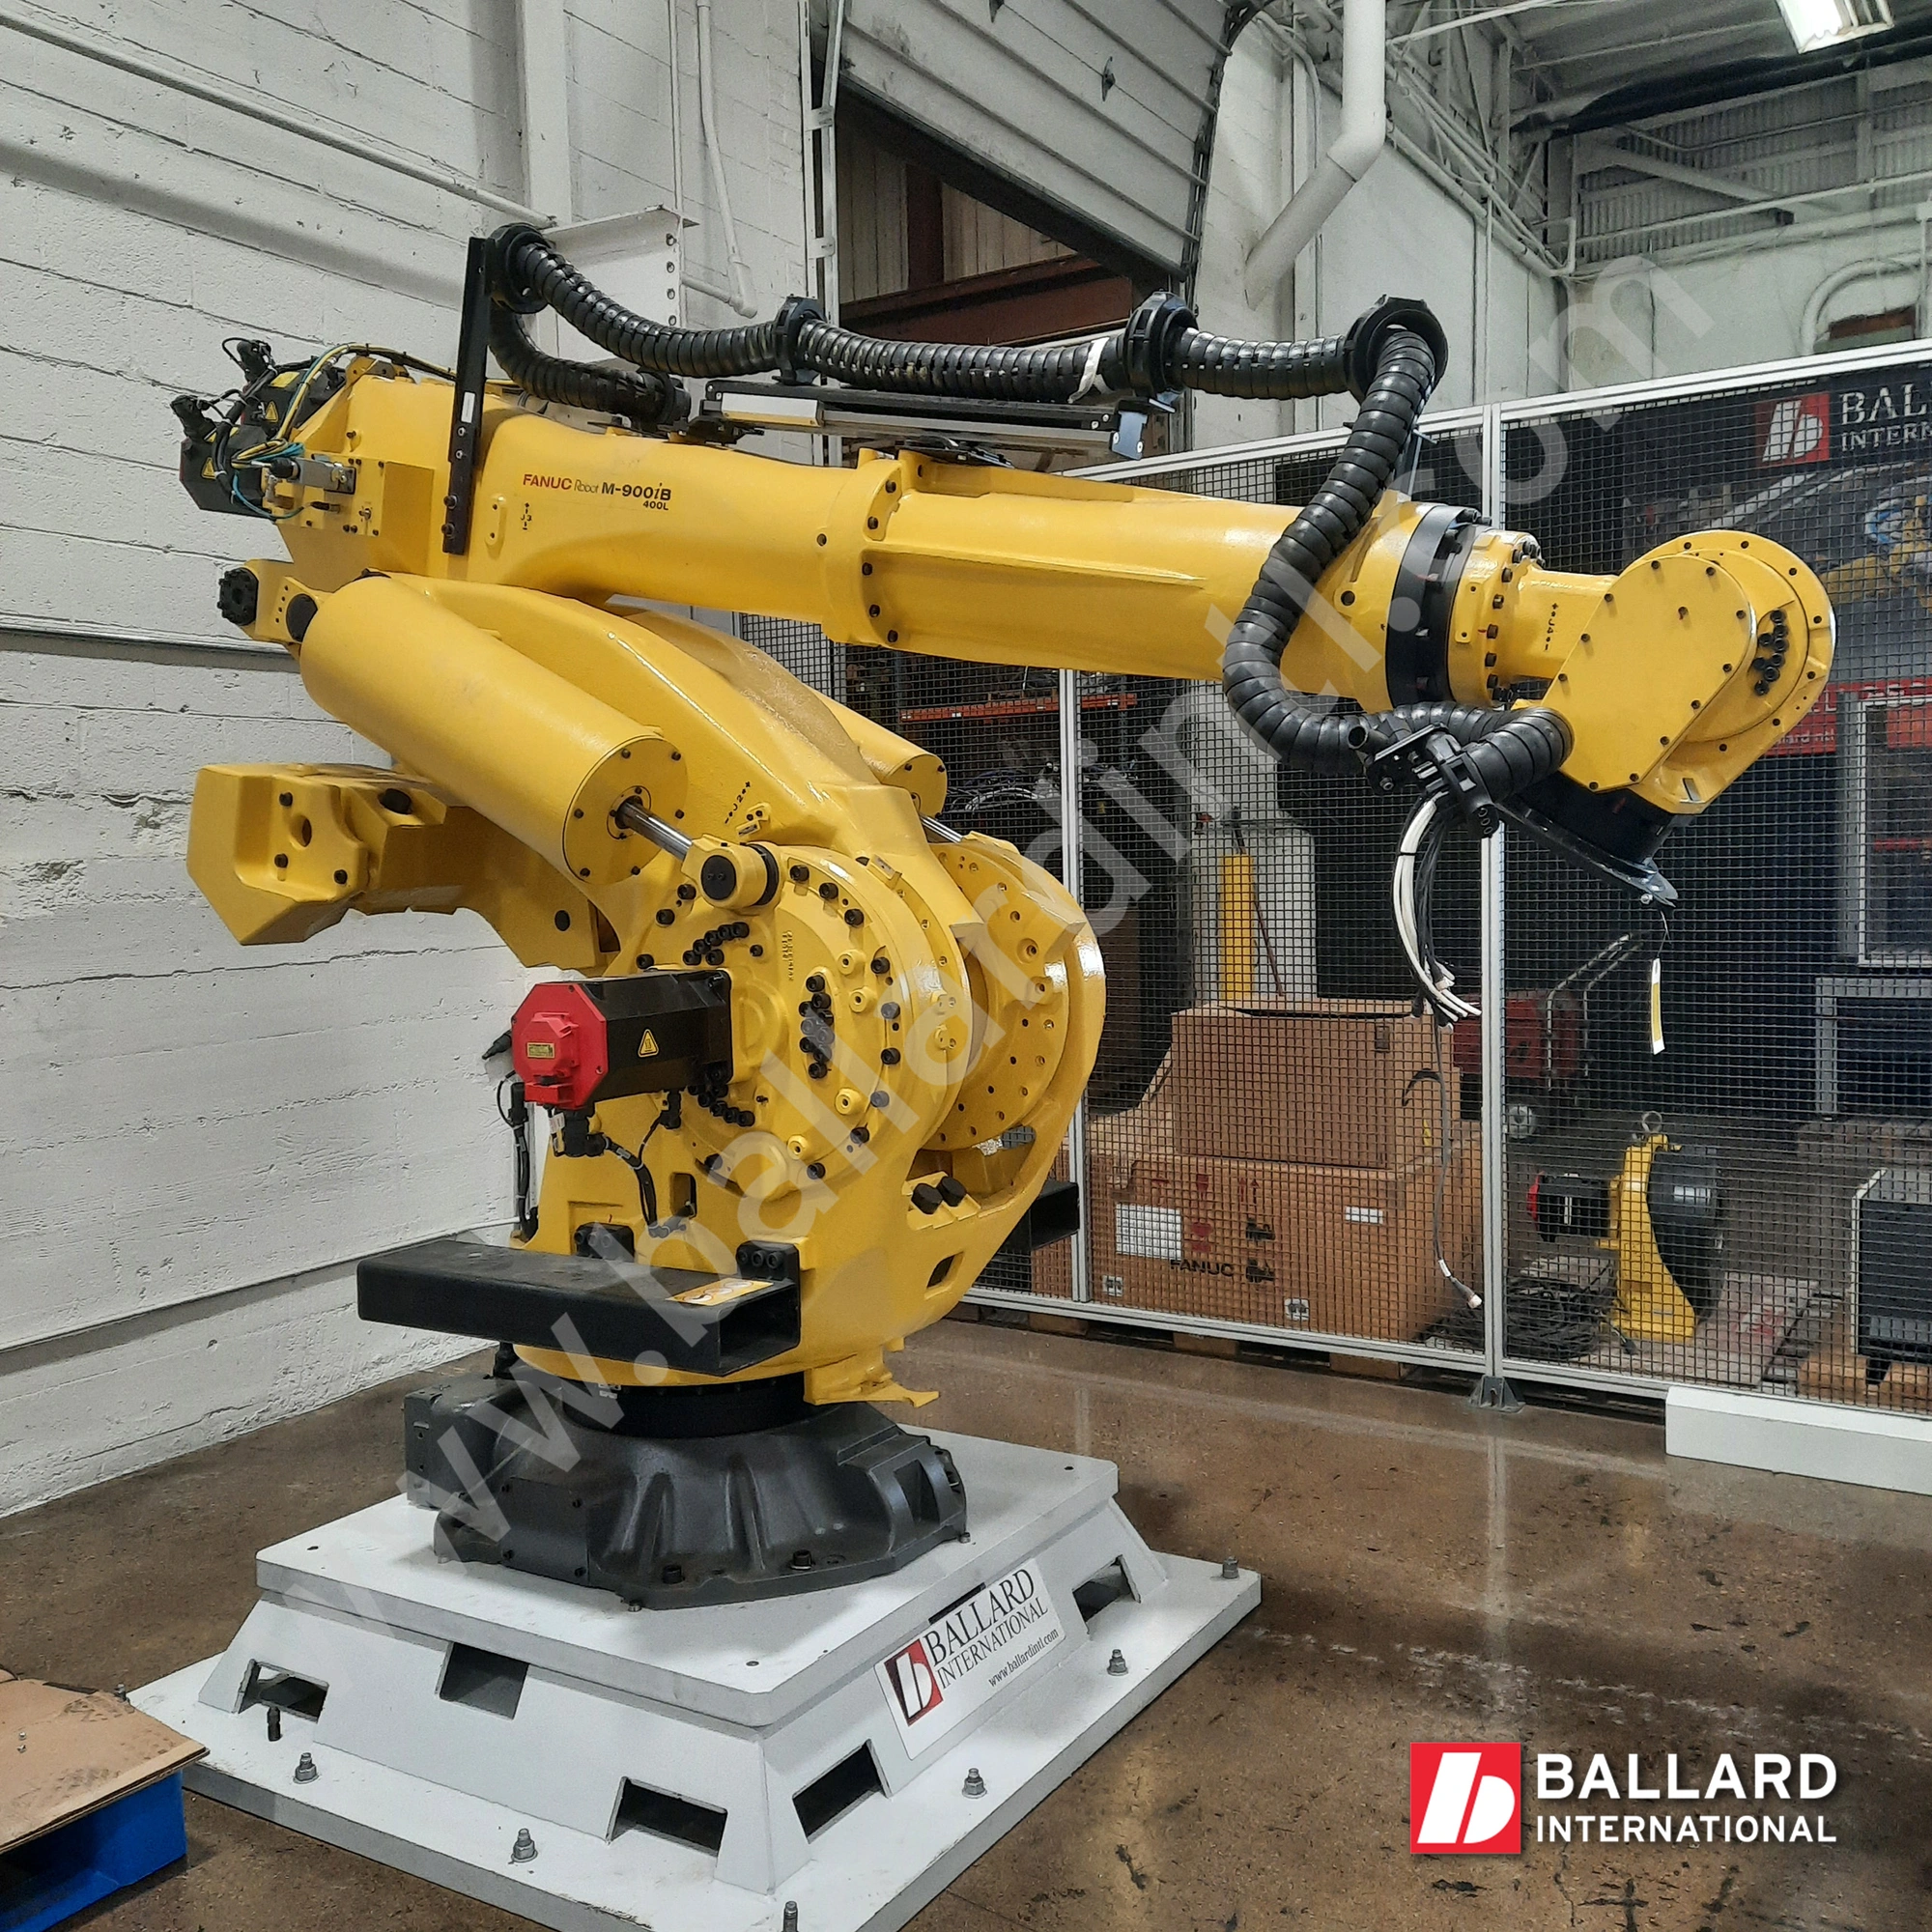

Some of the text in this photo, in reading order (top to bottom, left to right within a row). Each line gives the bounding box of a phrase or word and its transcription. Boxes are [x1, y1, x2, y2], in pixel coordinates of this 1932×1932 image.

[1839, 383, 1932, 425] BAL
[523, 473, 672, 501] FANUC Robot M-900iB
[642, 500, 669, 511] 400L
[1170, 1259, 1235, 1278] FANUC
[923, 1568, 1036, 1667] BALLARD
[935, 1596, 1049, 1690] INTERNATIONAL
[988, 1628, 1060, 1688] www.ballardintl.com
